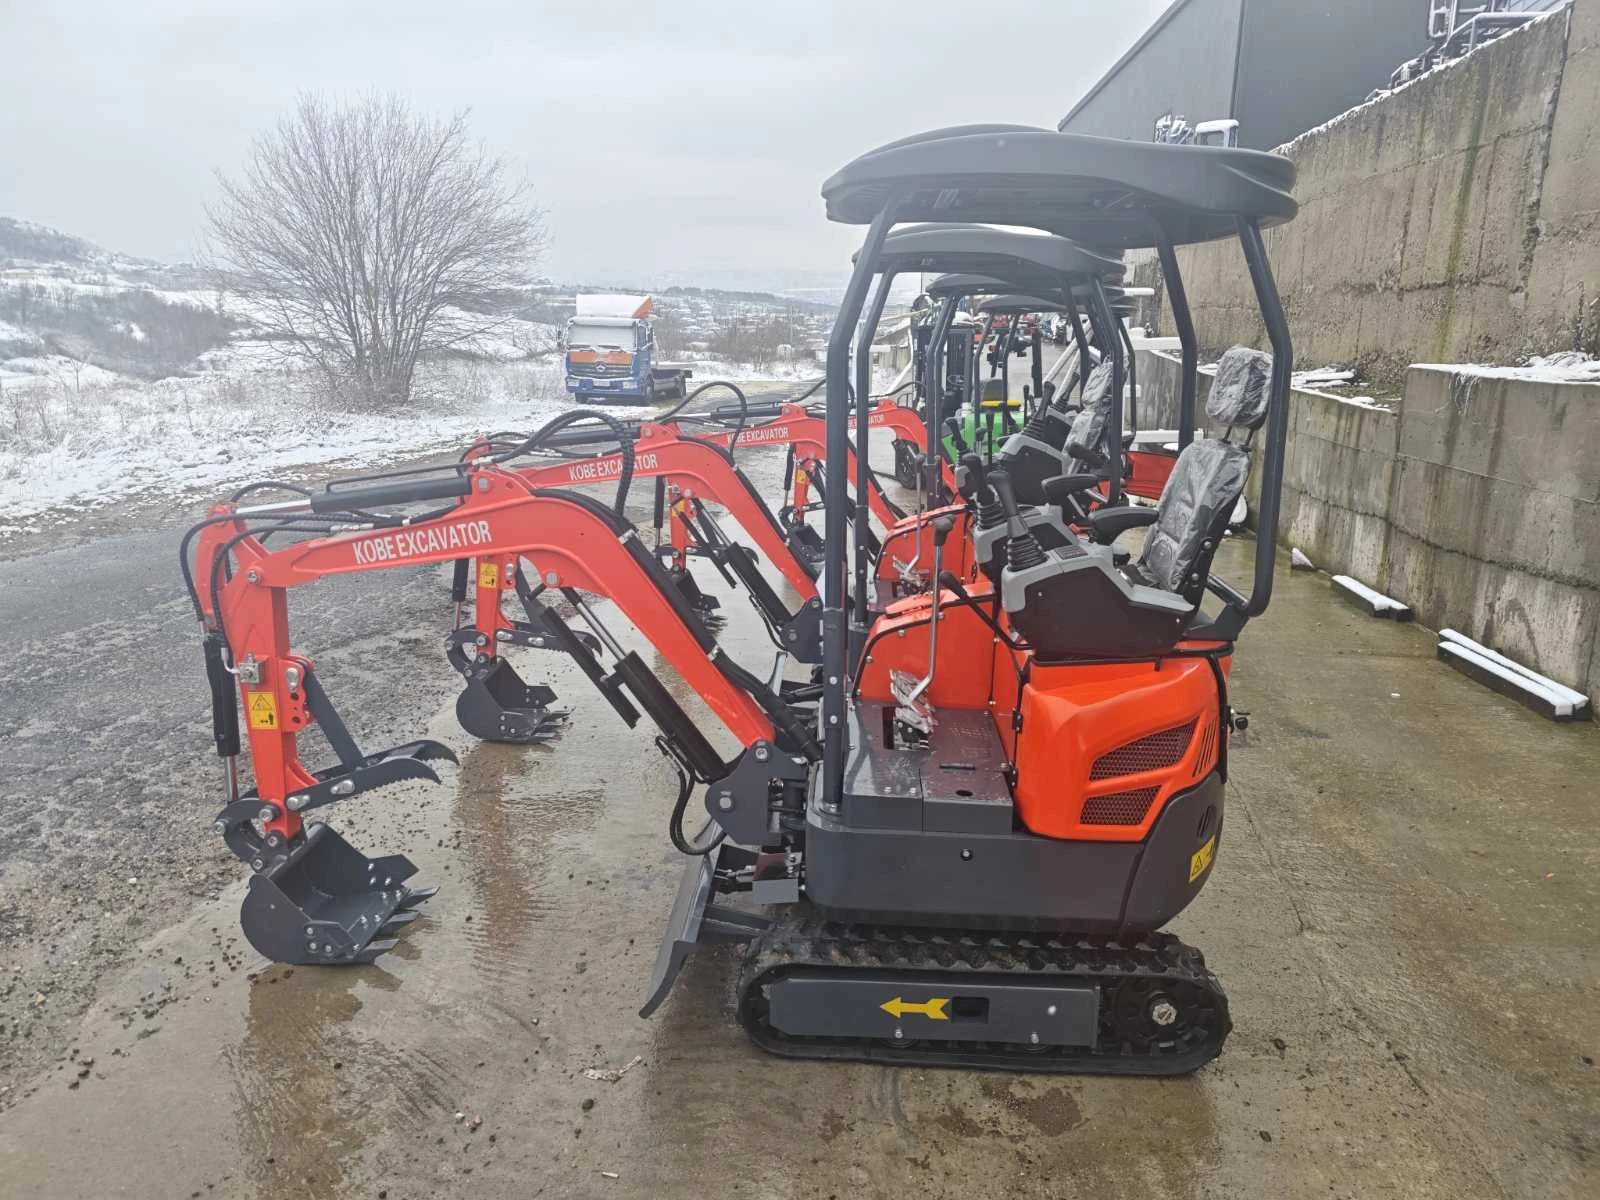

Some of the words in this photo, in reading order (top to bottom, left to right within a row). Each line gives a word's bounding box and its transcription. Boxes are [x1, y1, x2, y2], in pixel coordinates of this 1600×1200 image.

[746, 427, 789, 442] EXCAVATOR
[568, 463, 597, 480] KOBE
[352, 537, 396, 564] KOBE
[395, 520, 492, 557] EXCAVATOR
